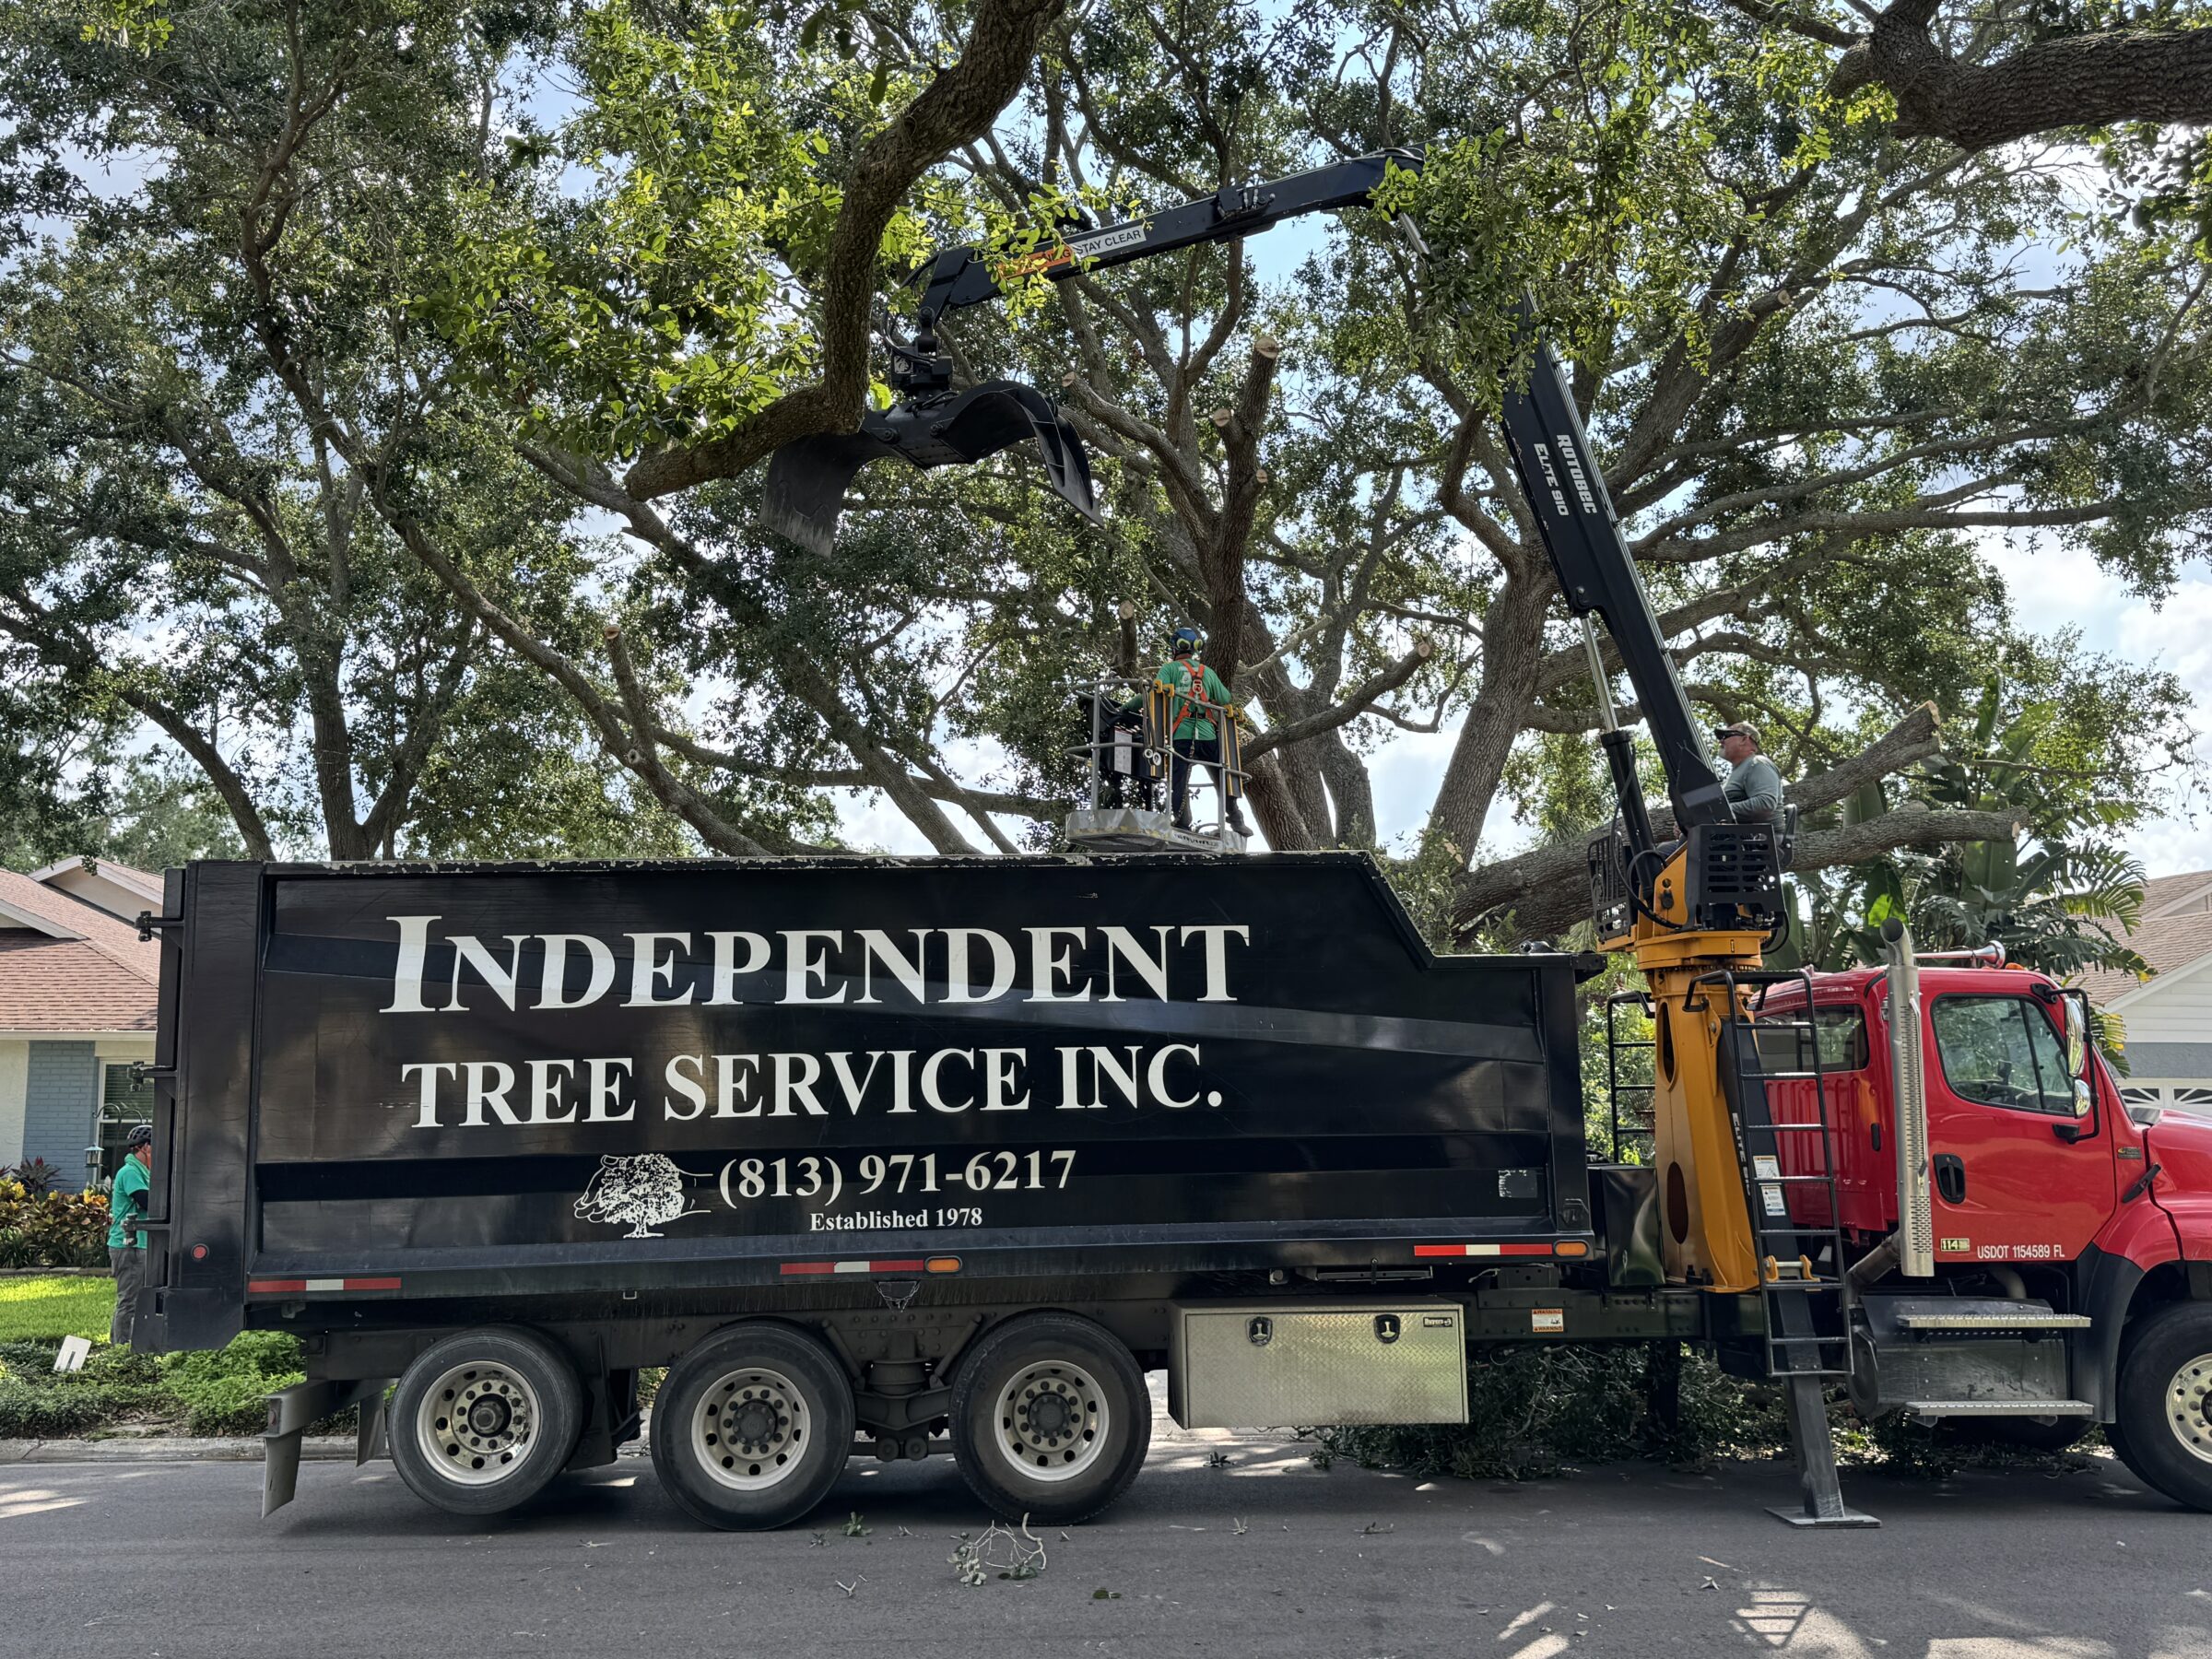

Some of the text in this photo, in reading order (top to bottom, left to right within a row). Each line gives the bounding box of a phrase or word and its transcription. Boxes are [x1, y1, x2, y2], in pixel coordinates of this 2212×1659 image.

[1077, 229, 1141, 255] STAY CLEAR
[1534, 443, 1569, 515] ELITE 910
[379, 915, 1250, 1013] INDEPENDENT
[400, 1042, 1224, 1128] TREE SERVICE INC.
[1732, 1112, 1747, 1162] ELITE
[719, 1150, 1077, 1209] (813) 971-6217
[809, 1207, 982, 1231] Established 1978
[1977, 1244, 2065, 1259] USDOT 1154589 FL
